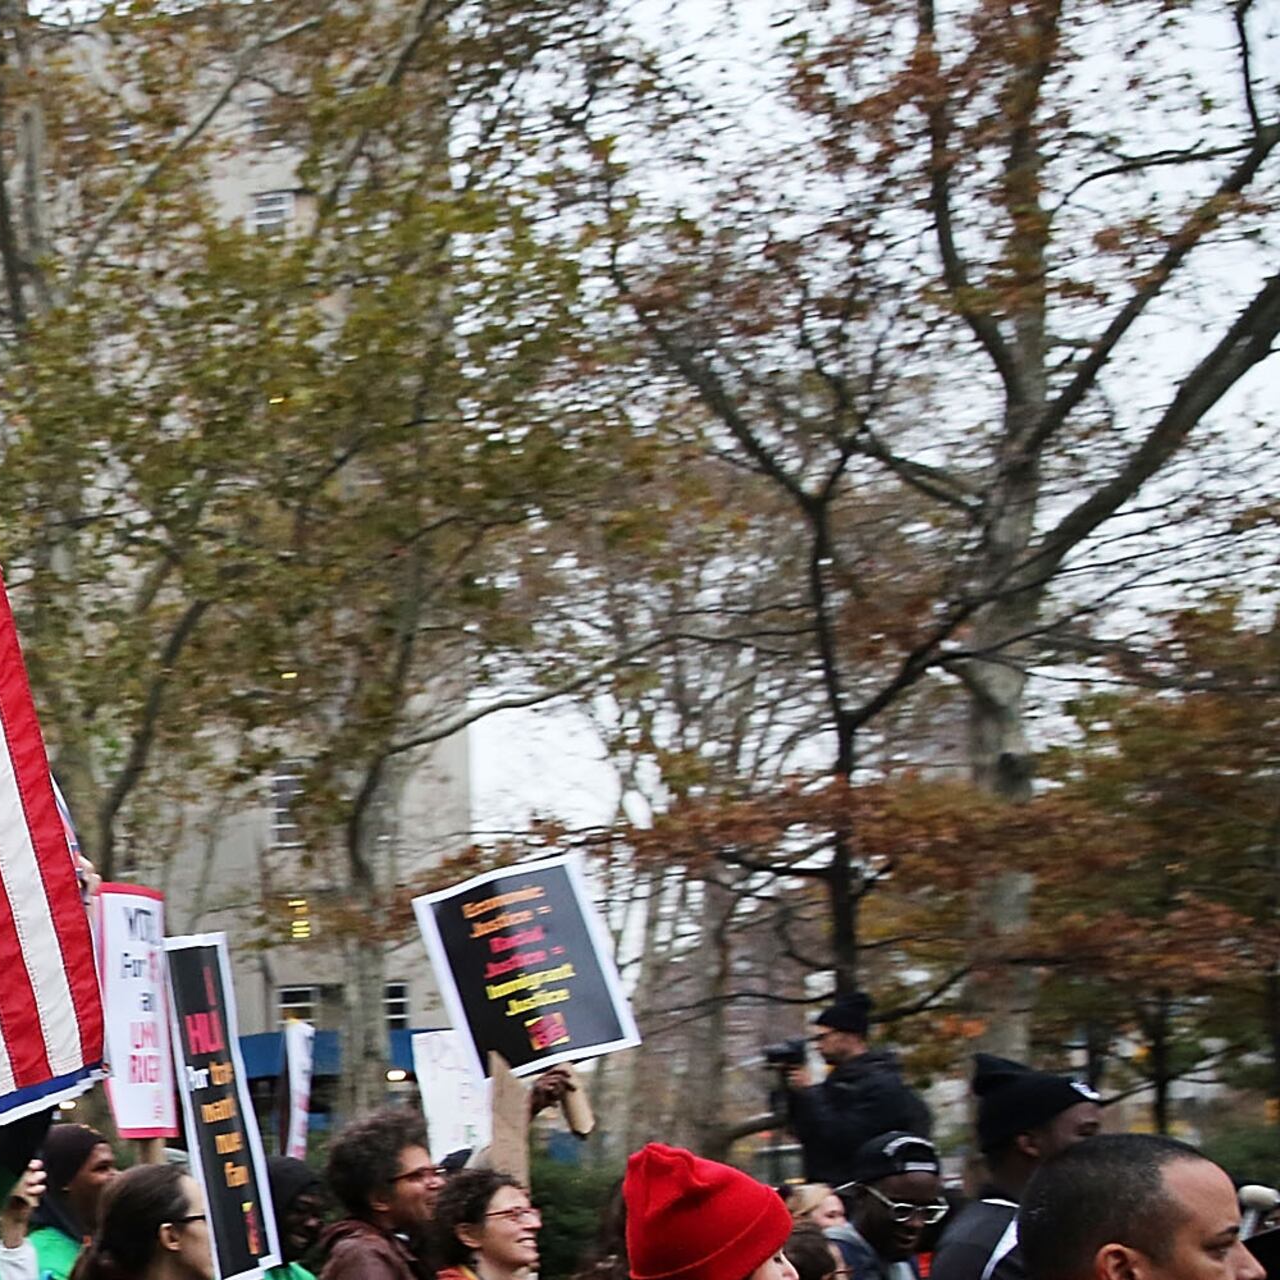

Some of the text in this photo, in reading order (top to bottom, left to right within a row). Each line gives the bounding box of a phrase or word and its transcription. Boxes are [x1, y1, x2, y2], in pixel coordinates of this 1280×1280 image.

[469, 909, 534, 938] Justice
[485, 963, 576, 1000] Immigrant
[505, 988, 570, 1016] Justice
